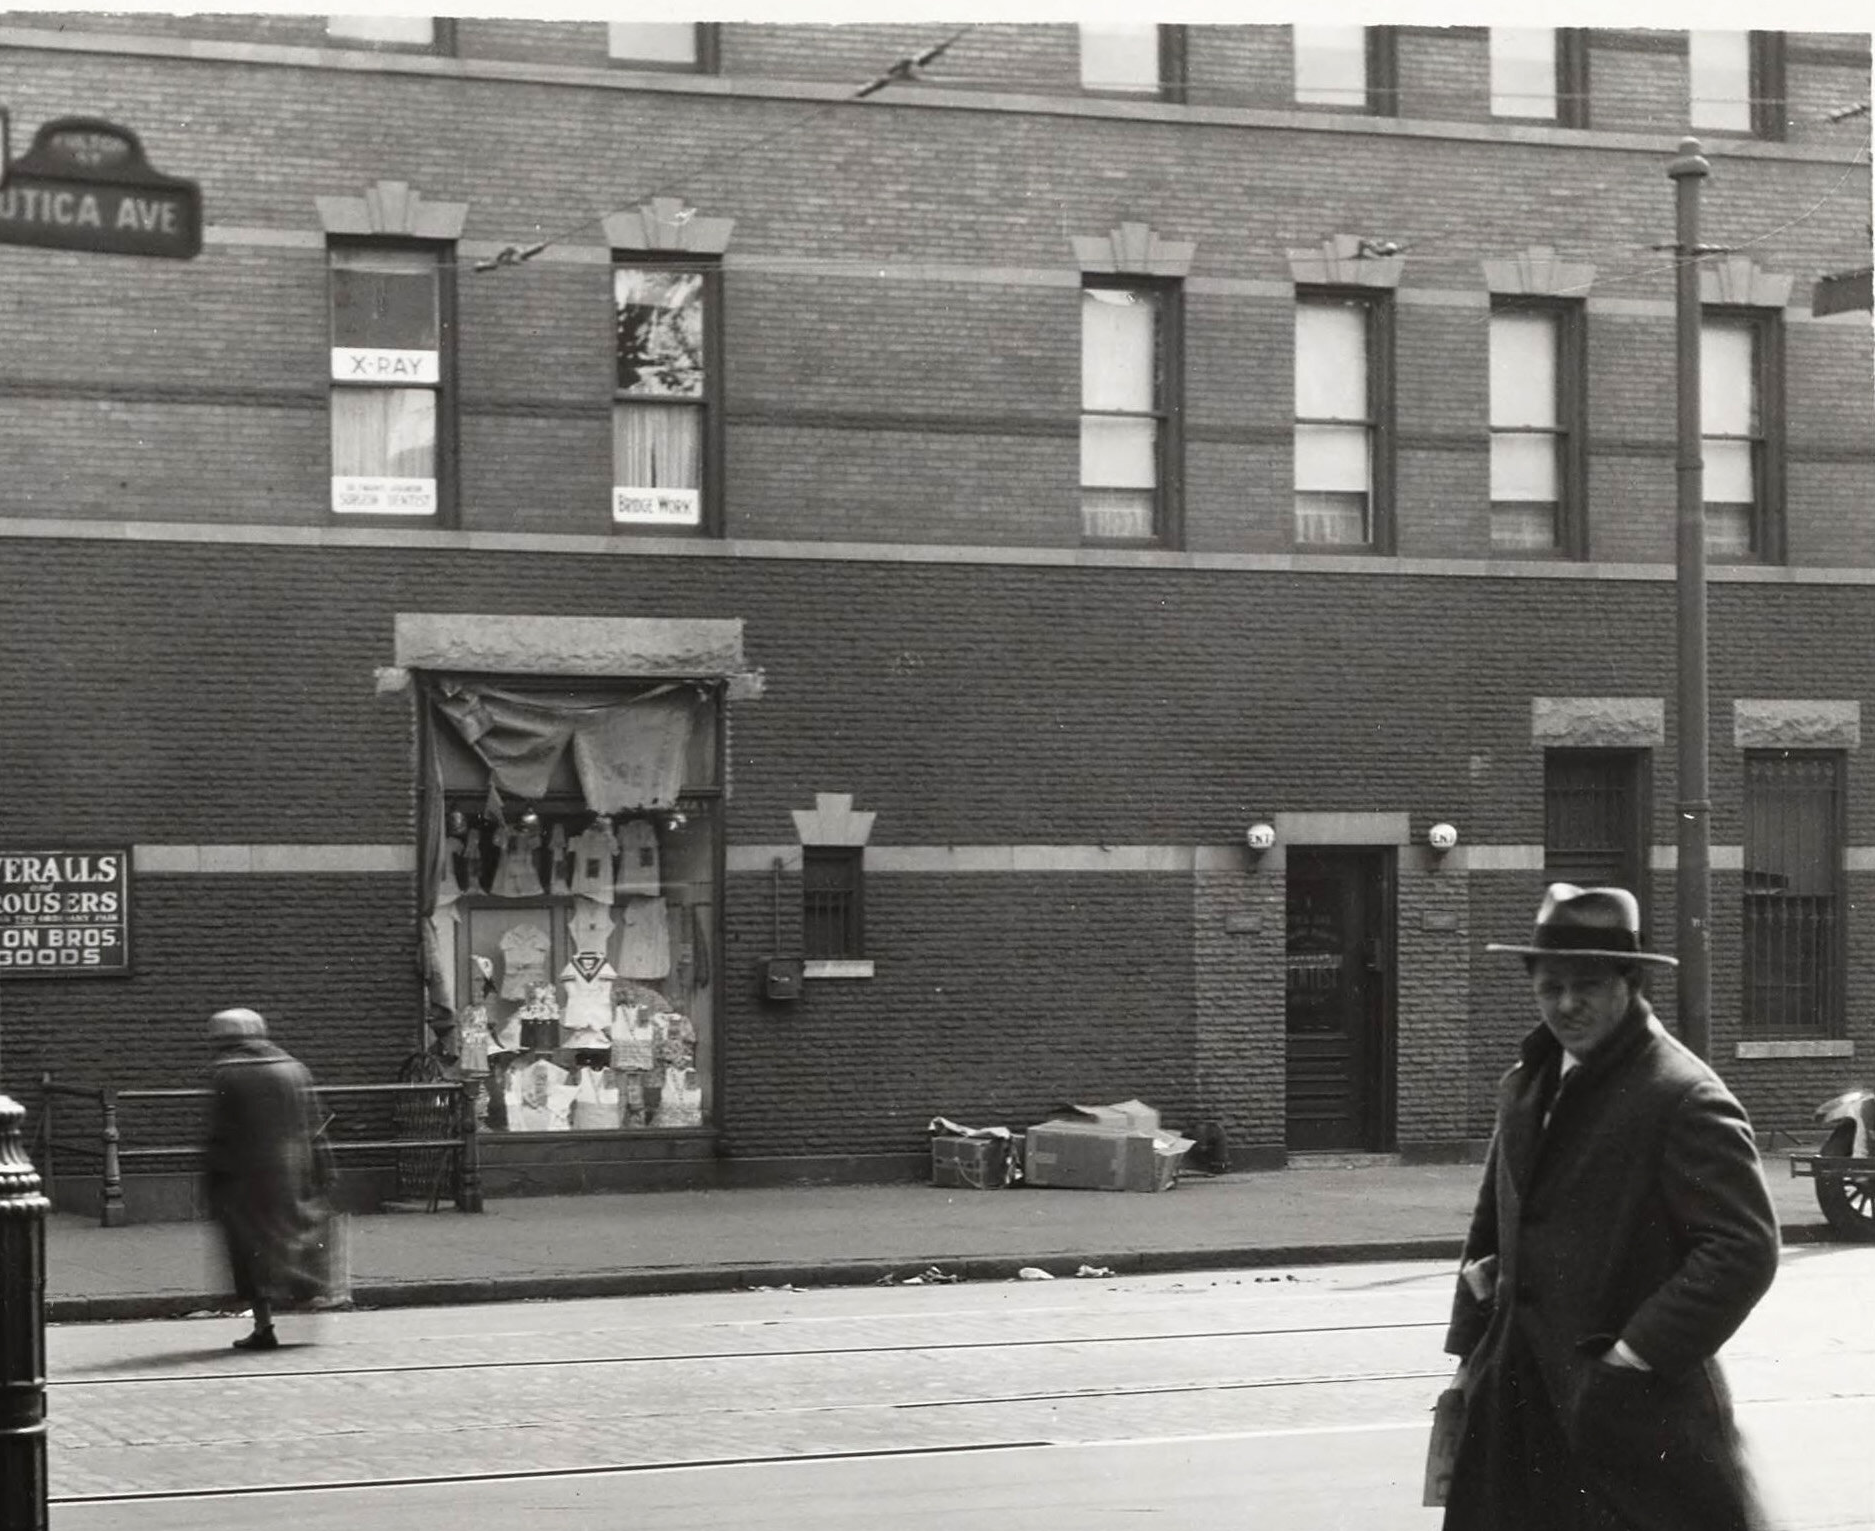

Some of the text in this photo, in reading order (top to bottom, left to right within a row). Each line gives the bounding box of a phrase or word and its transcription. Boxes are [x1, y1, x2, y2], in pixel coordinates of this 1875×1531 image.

[116, 197, 178, 234] AVE
[350, 355, 423, 376] X-RAY
[48, 928, 122, 947] BROS.
